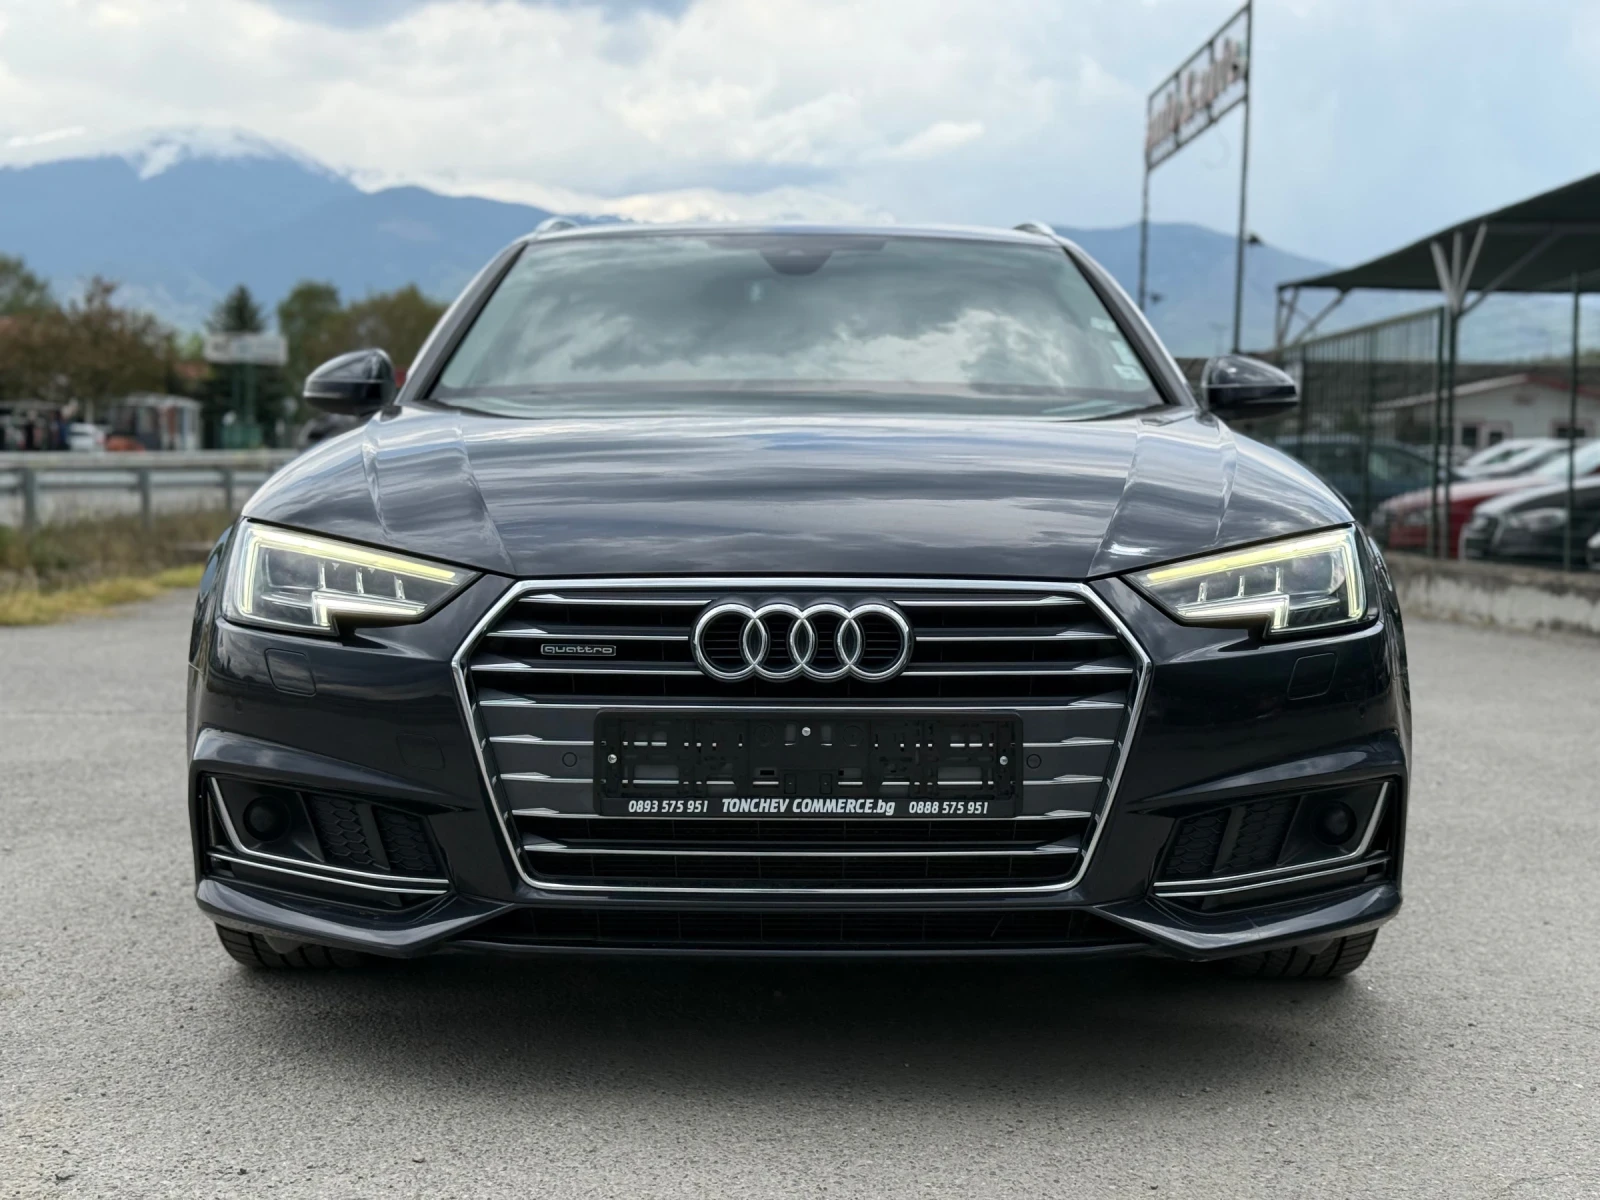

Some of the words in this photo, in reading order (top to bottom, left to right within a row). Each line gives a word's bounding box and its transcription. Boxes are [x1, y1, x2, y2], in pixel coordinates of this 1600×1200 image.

[544, 645, 613, 653] quattro
[628, 800, 658, 813] 0893
[661, 800, 684, 813] 575
[687, 800, 708, 813] 951
[722, 798, 789, 813] TONCHEV
[792, 798, 895, 816] COMMERCE.bg
[908, 801, 939, 814] 0888
[942, 801, 964, 814] 575
[967, 801, 989, 814] 951
